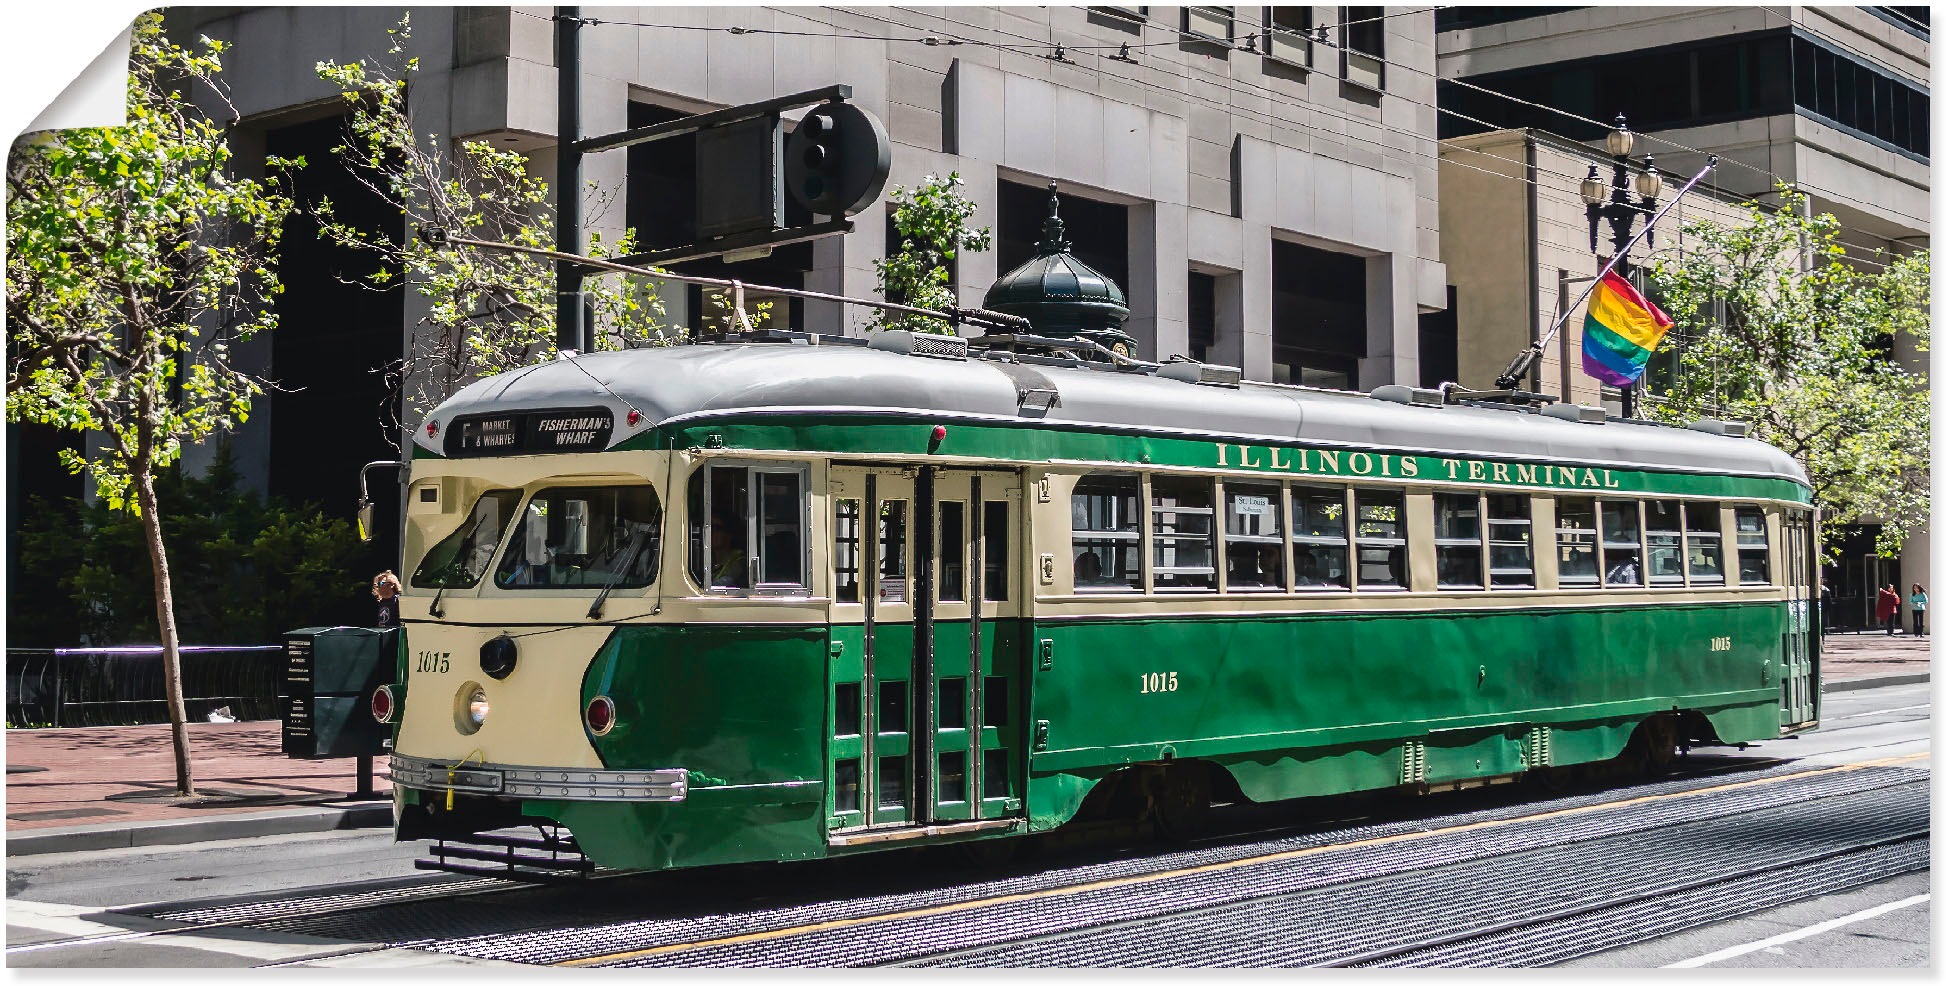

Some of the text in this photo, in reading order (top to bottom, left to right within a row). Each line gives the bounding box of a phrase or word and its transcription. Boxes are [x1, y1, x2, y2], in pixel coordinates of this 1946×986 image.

[482, 419, 511, 431] MARKET
[538, 417, 611, 431] FISHERMAN'S
[462, 422, 471, 448] F
[475, 435, 481, 447] &
[556, 431, 597, 445] WHARF
[1215, 442, 1620, 488] ILLINOIS TERMINAL
[1710, 636, 1731, 652] 1015
[416, 650, 451, 674] 1015
[1140, 671, 1179, 694] 1015
